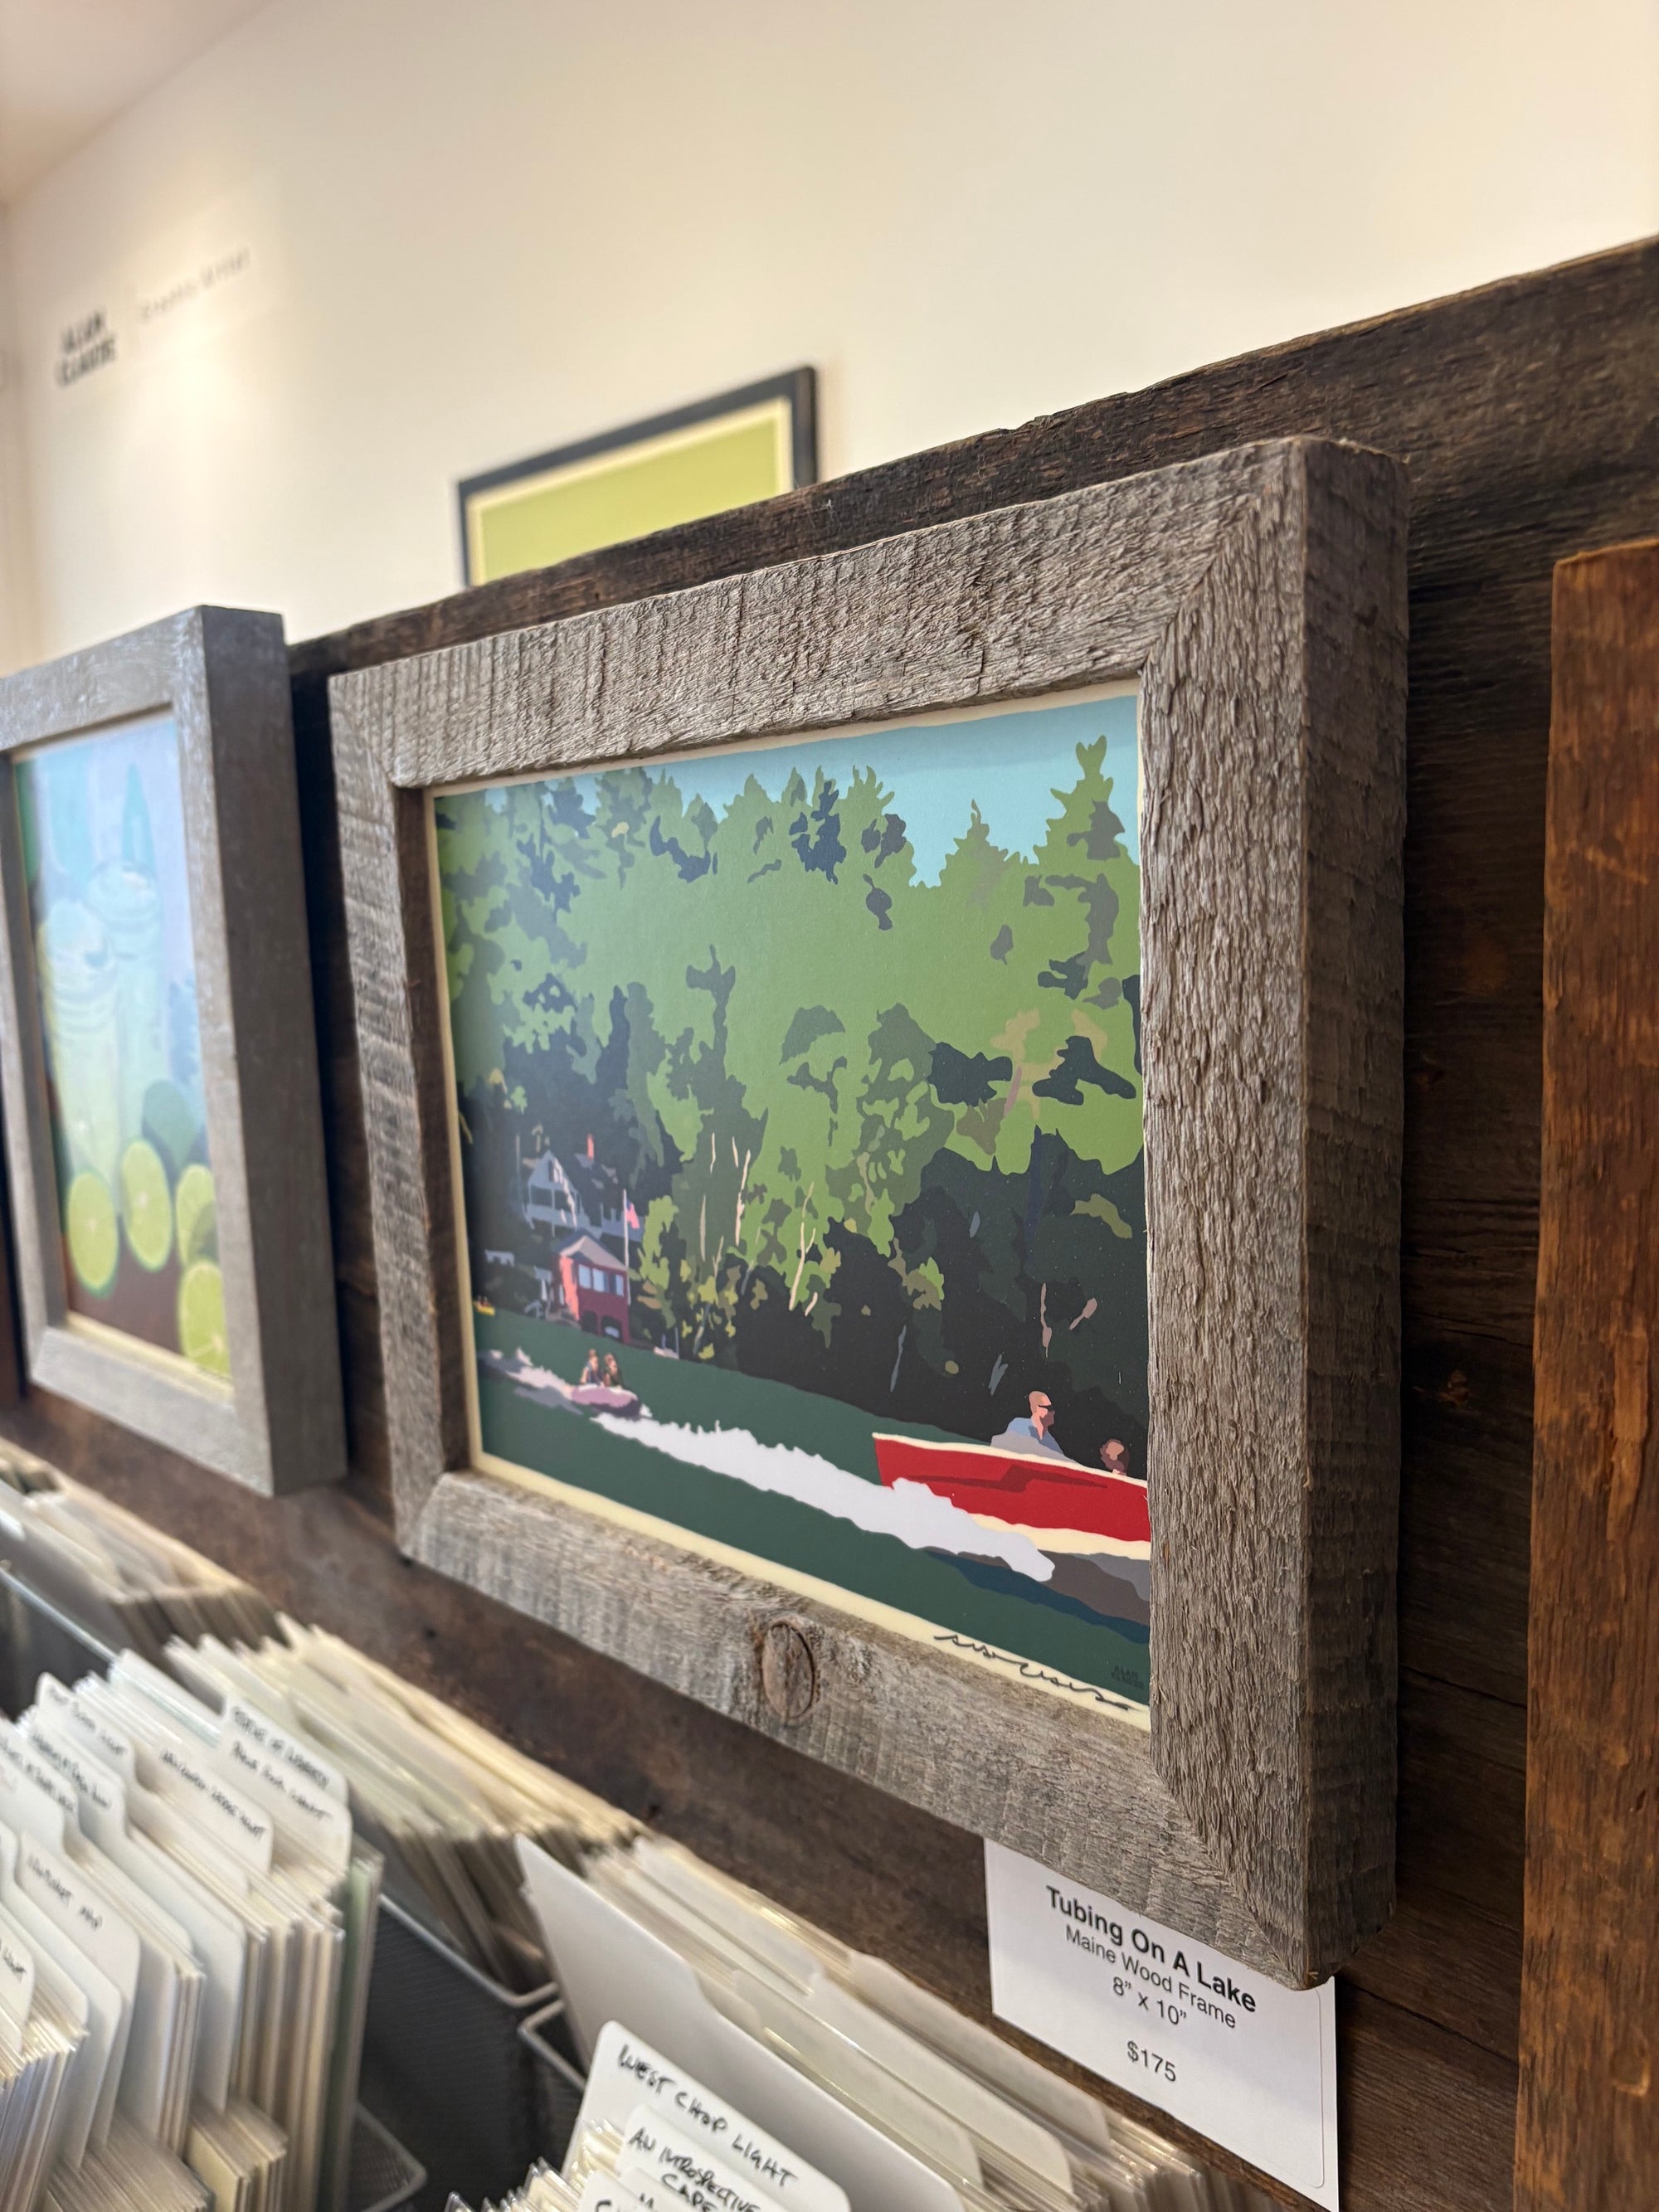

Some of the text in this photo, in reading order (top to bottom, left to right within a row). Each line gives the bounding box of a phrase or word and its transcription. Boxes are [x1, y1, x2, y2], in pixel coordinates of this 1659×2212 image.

[1046, 1884, 1256, 2013] Tubing On A Lake
[1066, 1924, 1236, 2029] Maine Wood Frame
[1137, 1991, 1150, 2010] x
[1127, 2040, 1176, 2082] $175
[618, 2044, 798, 2187] WEST CHOP LIGHT
